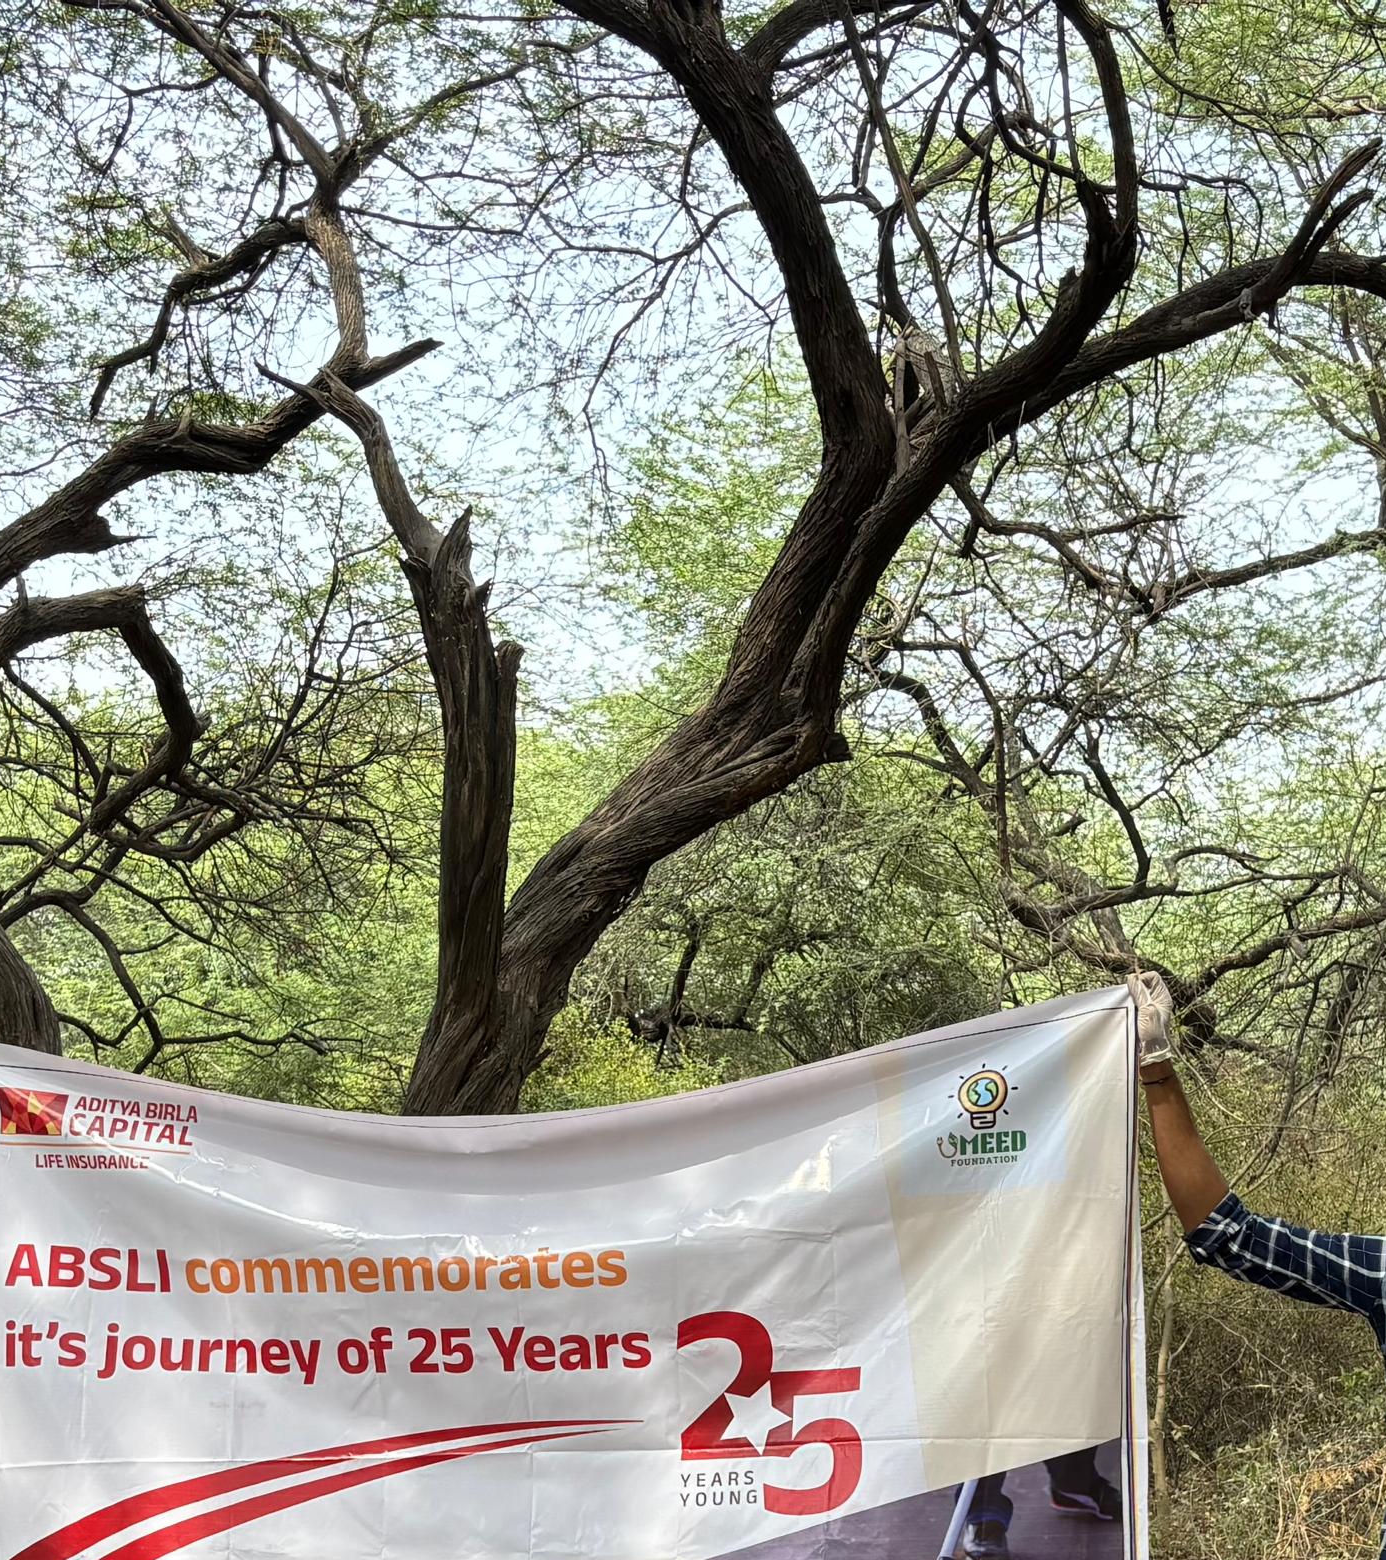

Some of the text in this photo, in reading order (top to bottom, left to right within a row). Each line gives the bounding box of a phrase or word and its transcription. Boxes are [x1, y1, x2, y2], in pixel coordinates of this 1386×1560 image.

[74, 1096, 198, 1123] ADITYA BIRLA
[69, 1114, 193, 1146] CAPITAL
[35, 1153, 150, 1170] LIFE INSURANCE
[950, 1155, 1018, 1167] FOUNDATION
[4, 1243, 628, 1294] ABSLI commemorates
[5, 1320, 652, 1385] it’s journey of 25 Years
[680, 1470, 755, 1488] YEARS
[680, 1489, 758, 1507] YOUNG
